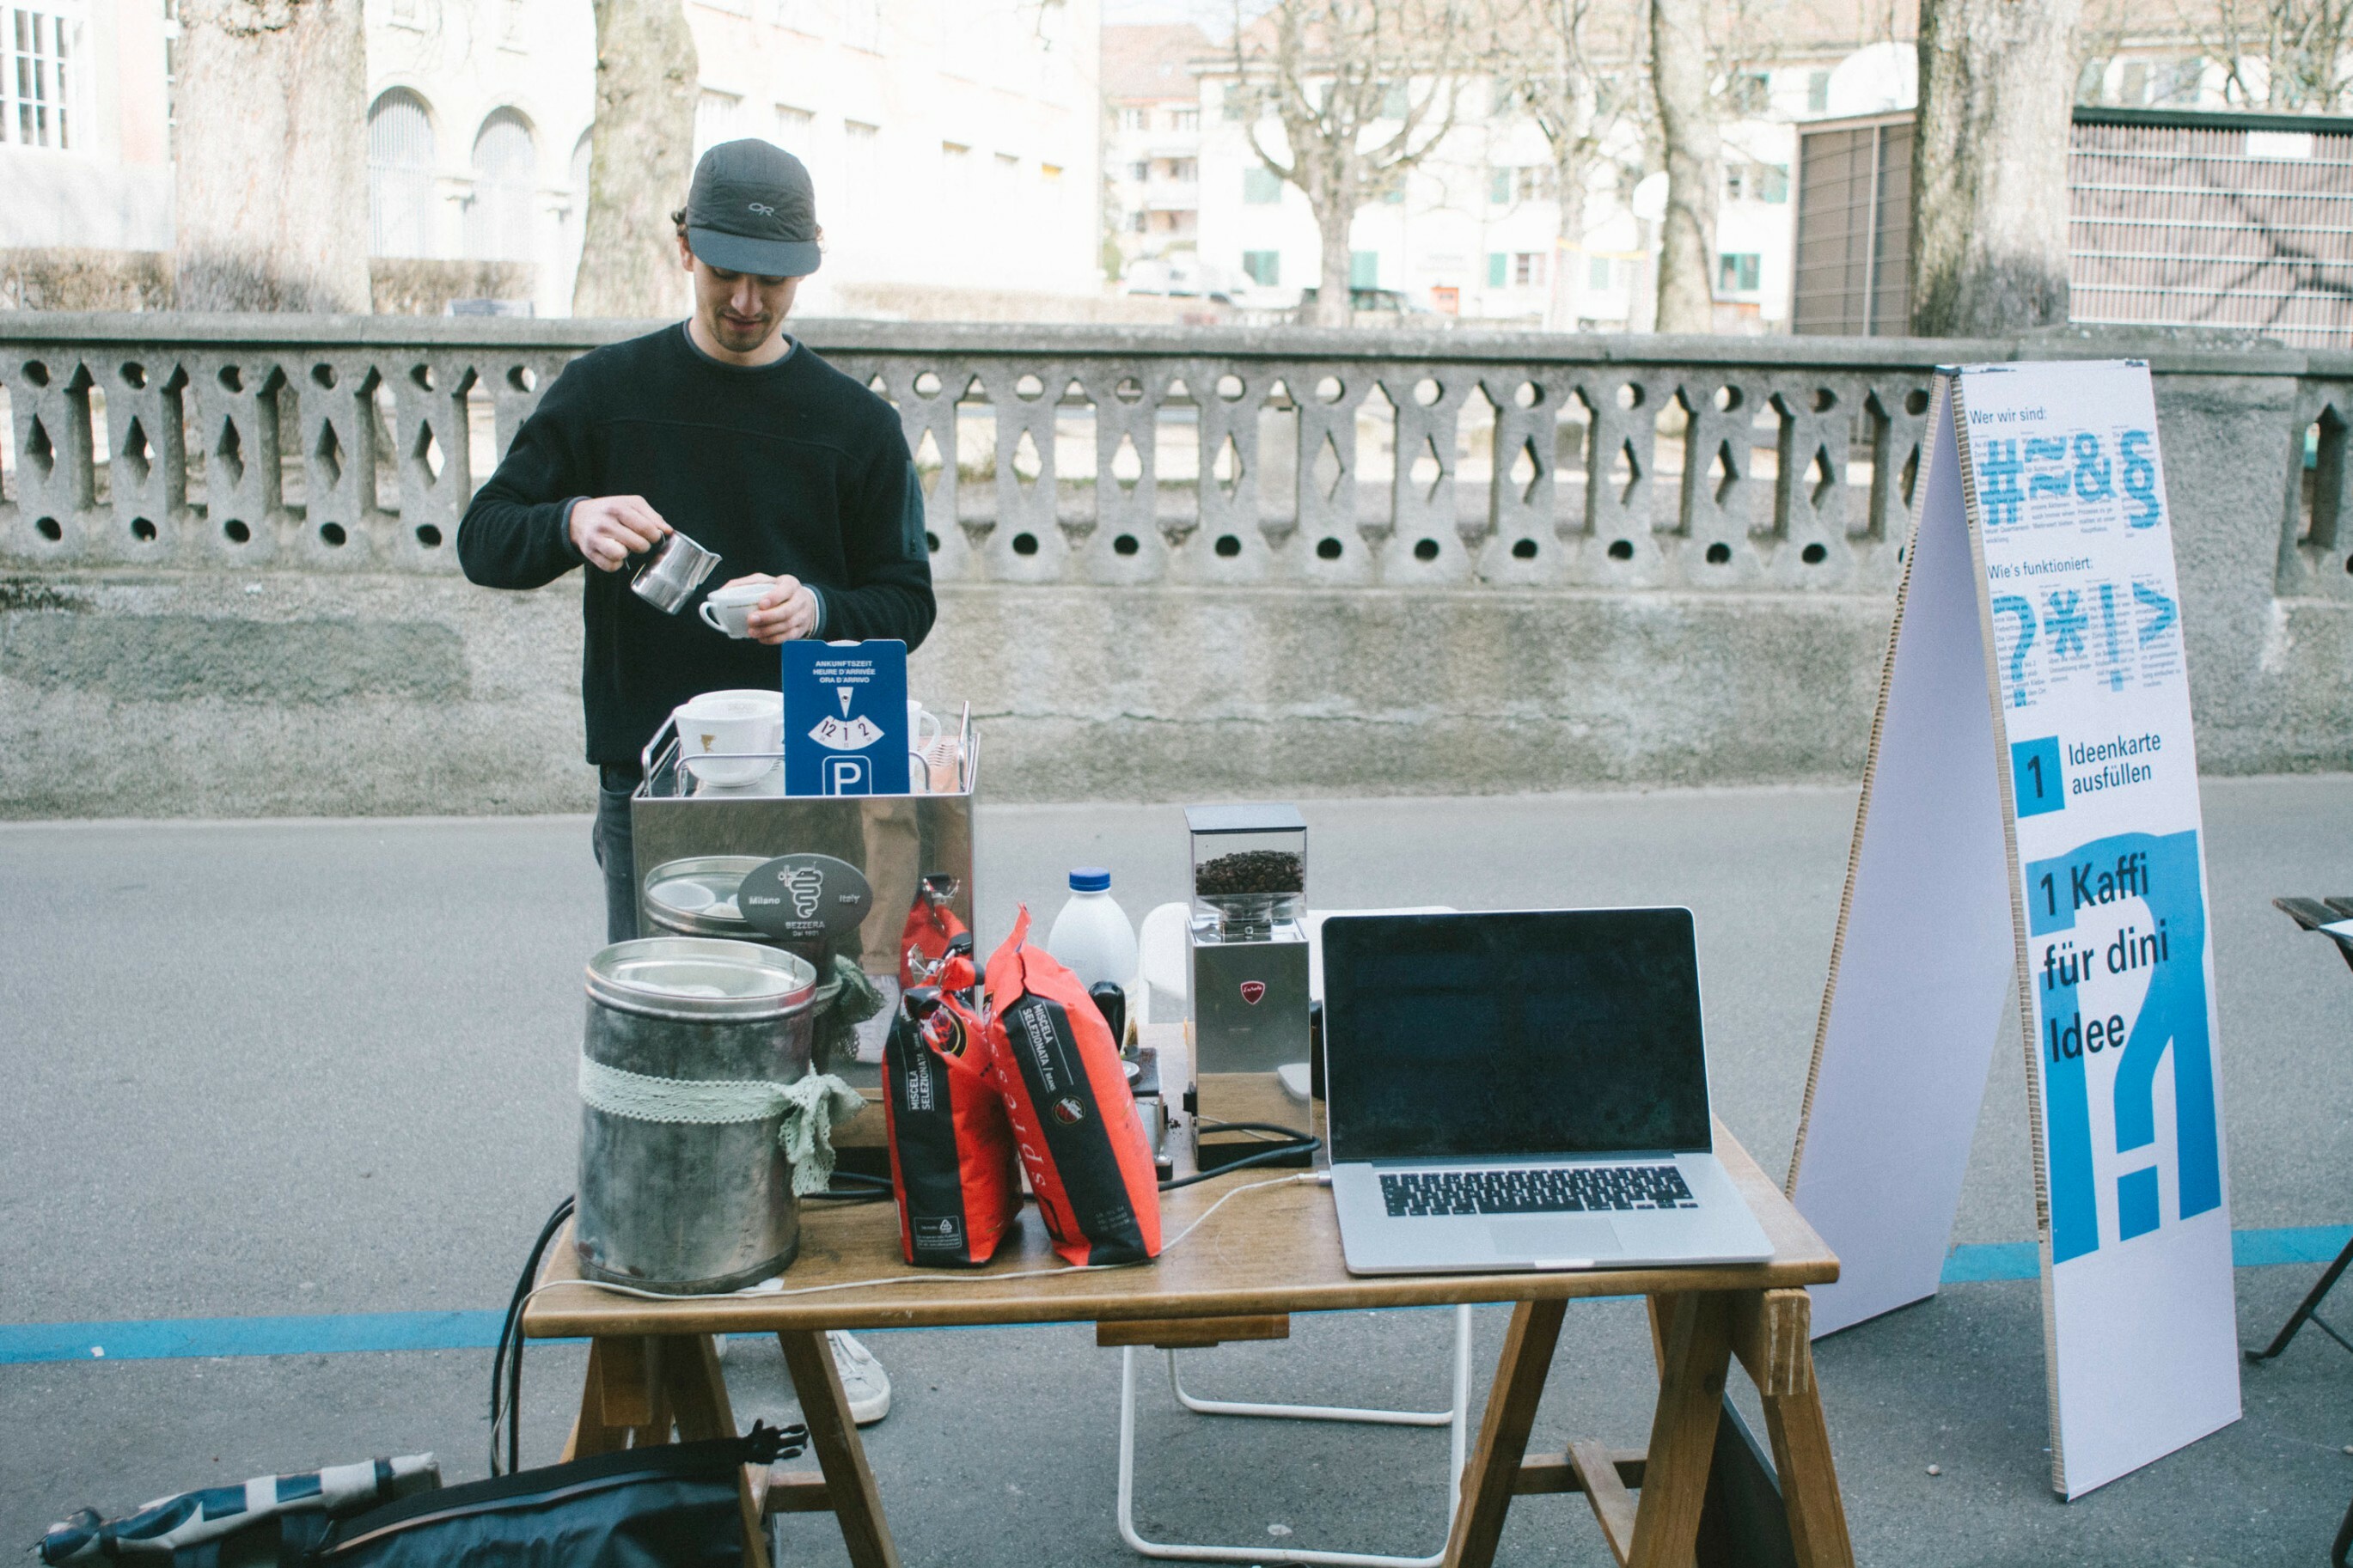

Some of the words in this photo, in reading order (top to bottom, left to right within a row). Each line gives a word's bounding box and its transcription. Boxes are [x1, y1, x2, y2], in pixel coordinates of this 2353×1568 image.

[749, 202, 775, 217] OR
[1970, 410, 1993, 425] Wer
[1998, 408, 2016, 424] wir
[2020, 406, 2047, 422] sind:
[1988, 563, 2020, 579] Wie's
[2024, 557, 2093, 577] funktioniert:
[821, 721, 837, 737] 12
[843, 727, 848, 741] 1
[858, 723, 870, 736] 2
[2069, 732, 2161, 766] Ideenkarte
[834, 762, 862, 796] P
[2027, 754, 2044, 799] 1
[2072, 762, 2152, 795] ausfüllen
[749, 896, 780, 905] Milano
[839, 894, 861, 904] Italy
[2040, 872, 2056, 917] 1
[2071, 851, 2148, 911] Kaffi
[785, 921, 825, 930] BEZZERA
[2044, 941, 2094, 991] für
[2107, 918, 2168, 974] dini
[1023, 1007, 1050, 1067] SELEZIONATA
[1033, 1004, 1054, 1045] MISCELA
[2050, 1011, 2125, 1063] Idee
[909, 1070, 920, 1110] MISCELA
[917, 1052, 931, 1111] SELEZIONATA
